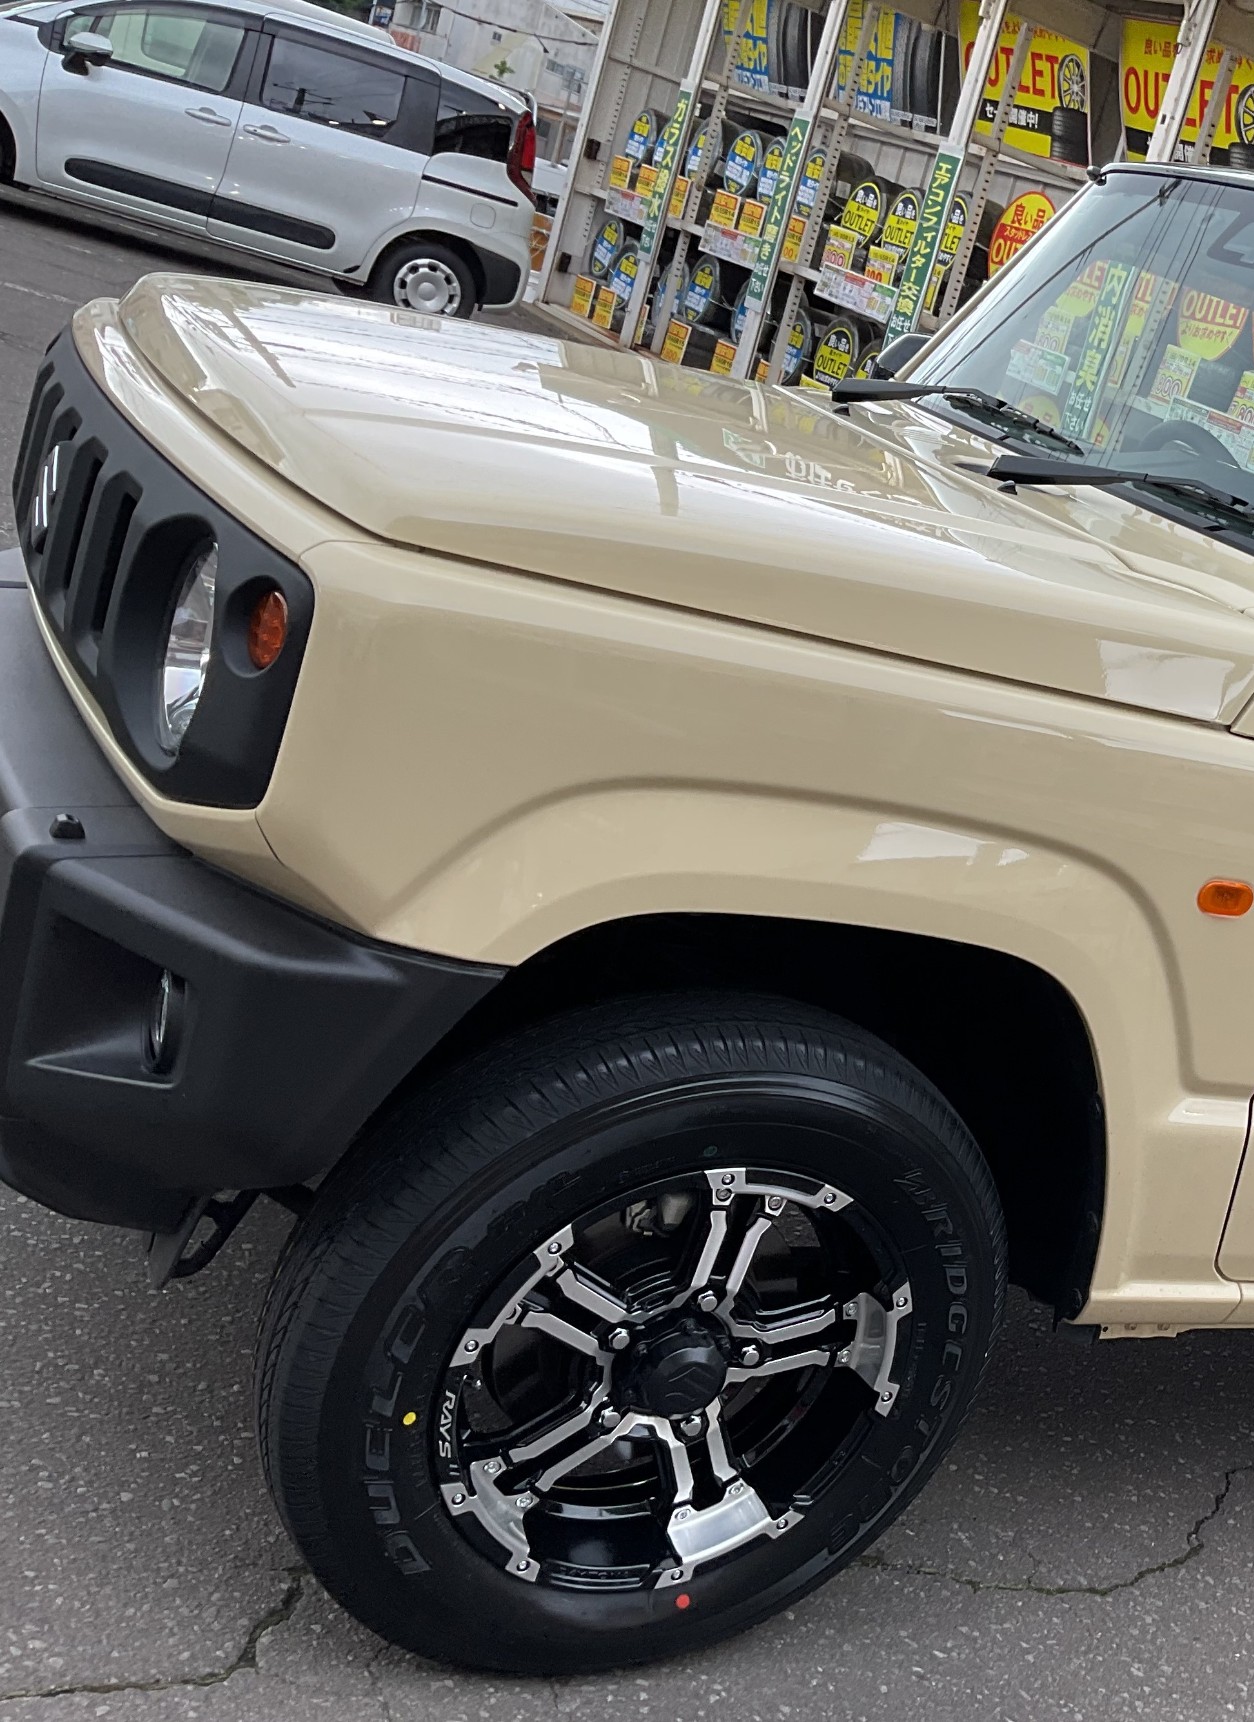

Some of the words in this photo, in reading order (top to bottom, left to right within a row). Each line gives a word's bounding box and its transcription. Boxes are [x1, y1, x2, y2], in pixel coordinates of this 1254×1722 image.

[844, 210, 875, 234] OUTLET
[884, 226, 914, 247] OUTLET
[897, 162, 952, 316] エアコンフィルター交換
[1182, 289, 1246, 327] OUTLET
[817, 354, 848, 378] OUTLET
[437, 1387, 456, 1460] RAYS
